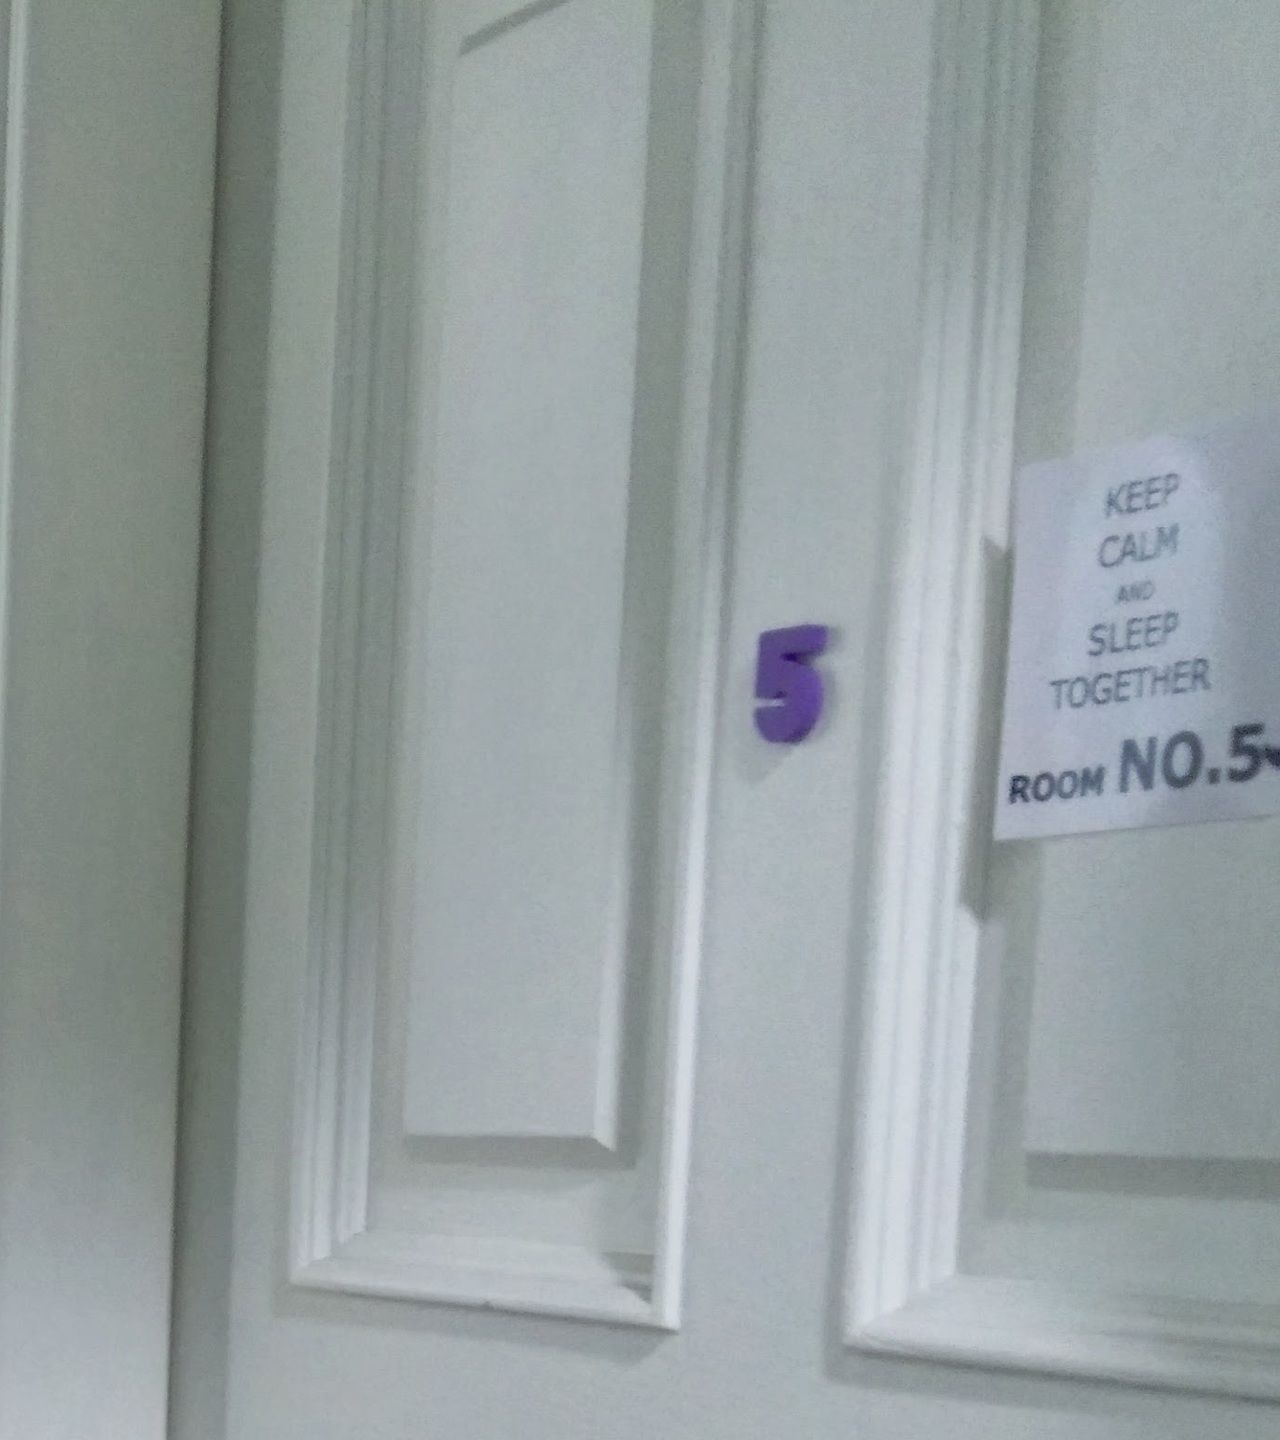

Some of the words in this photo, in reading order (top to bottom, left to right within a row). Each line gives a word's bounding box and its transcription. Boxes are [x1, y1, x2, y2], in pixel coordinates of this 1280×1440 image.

[1105, 473, 1180, 517] KEEP
[1098, 523, 1180, 568] CALM
[1117, 580, 1155, 603] AND
[1088, 611, 1179, 657] SLEEP
[753, 623, 829, 746] 5
[1050, 657, 1212, 710] TOGETHER
[1009, 764, 1106, 804] ROOM
[1119, 722, 1266, 794] NO.5
